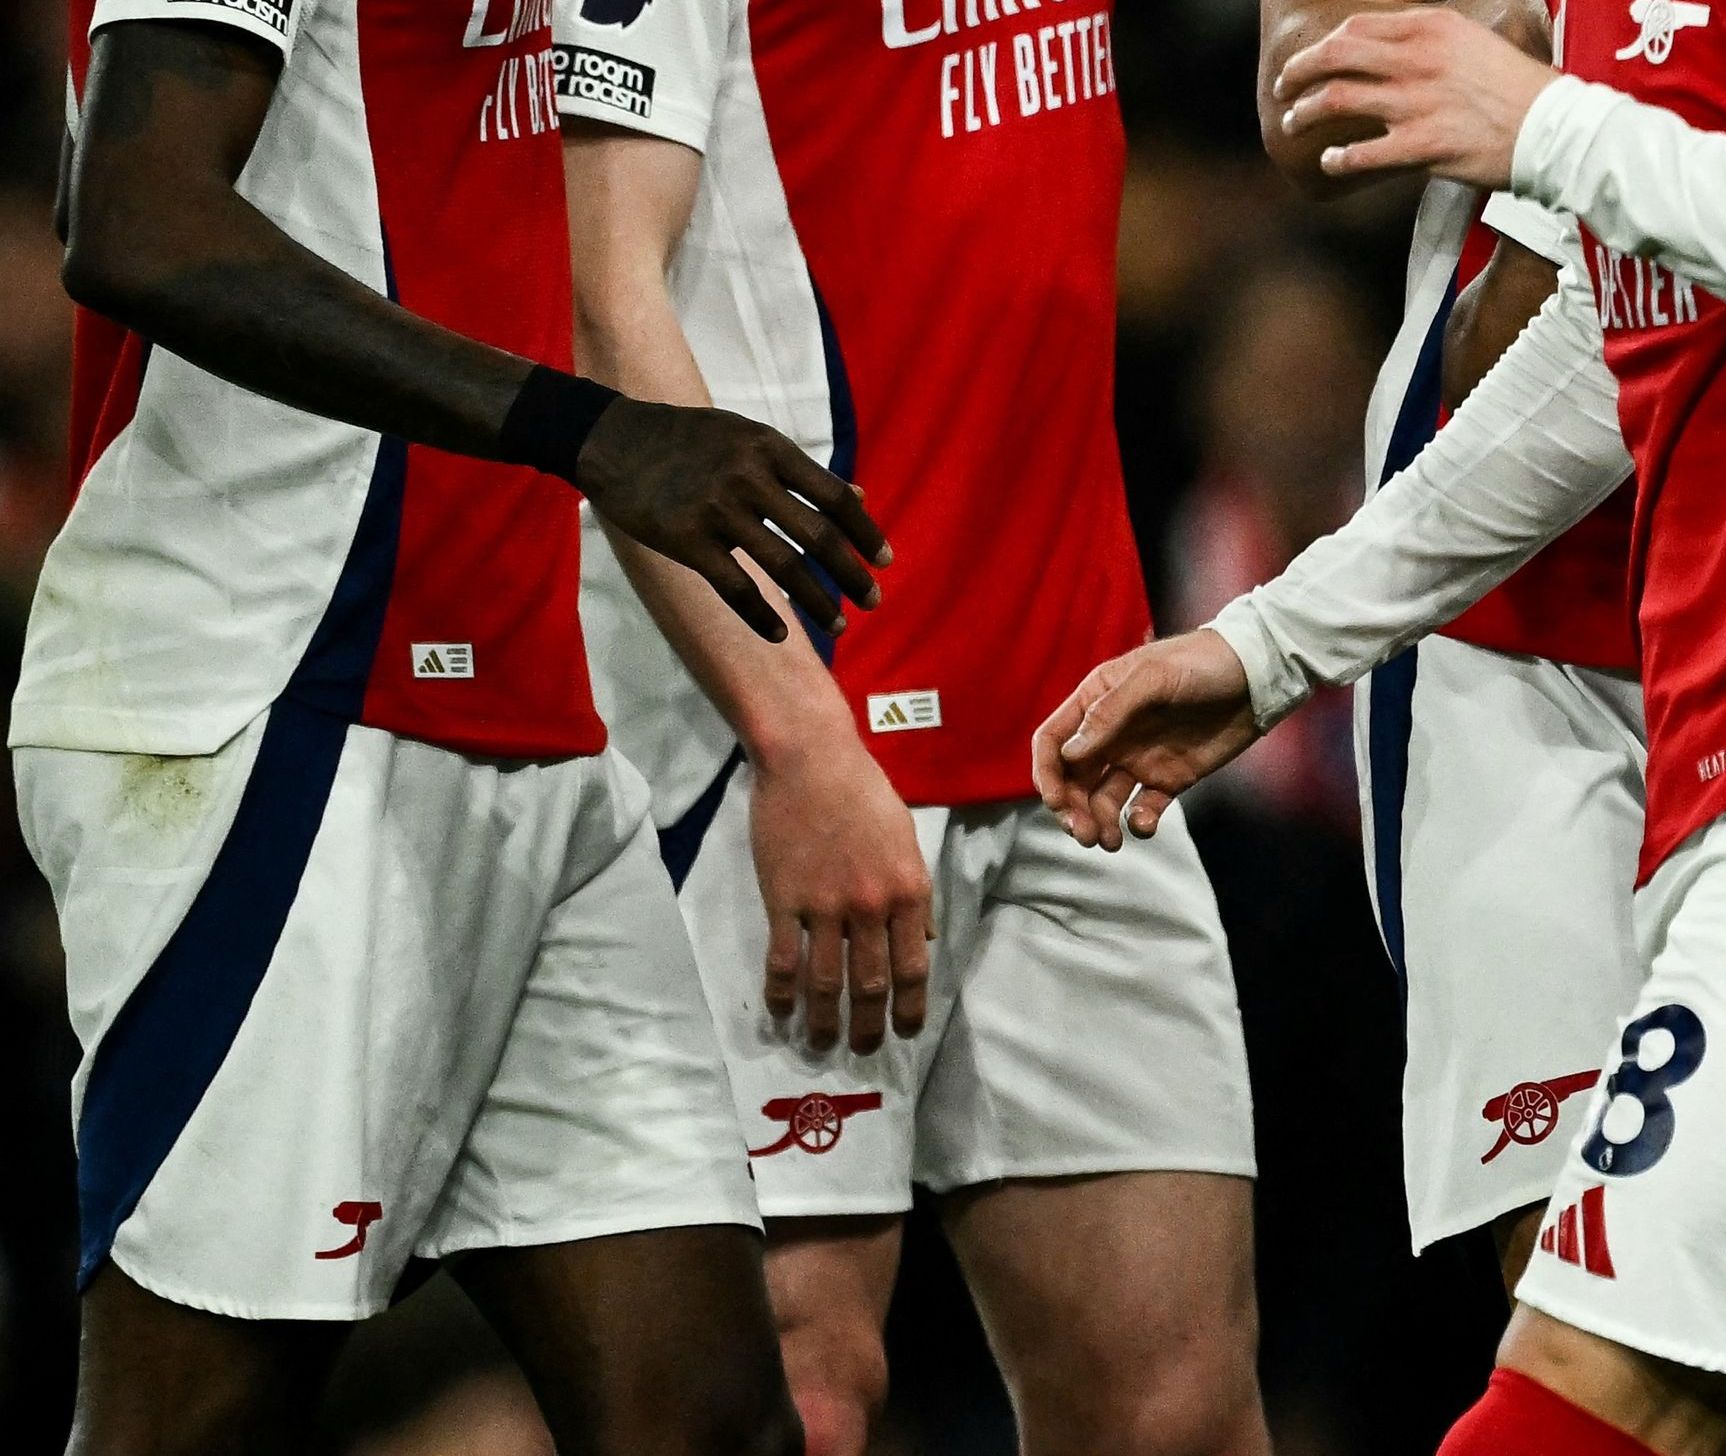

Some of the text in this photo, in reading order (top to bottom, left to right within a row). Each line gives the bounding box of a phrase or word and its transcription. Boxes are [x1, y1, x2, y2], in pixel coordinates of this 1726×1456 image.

[568, 75, 650, 118] racism
[574, 52, 643, 91] room
[940, 41, 1000, 138] FLY
[1581, 1004, 1706, 1177] 8
